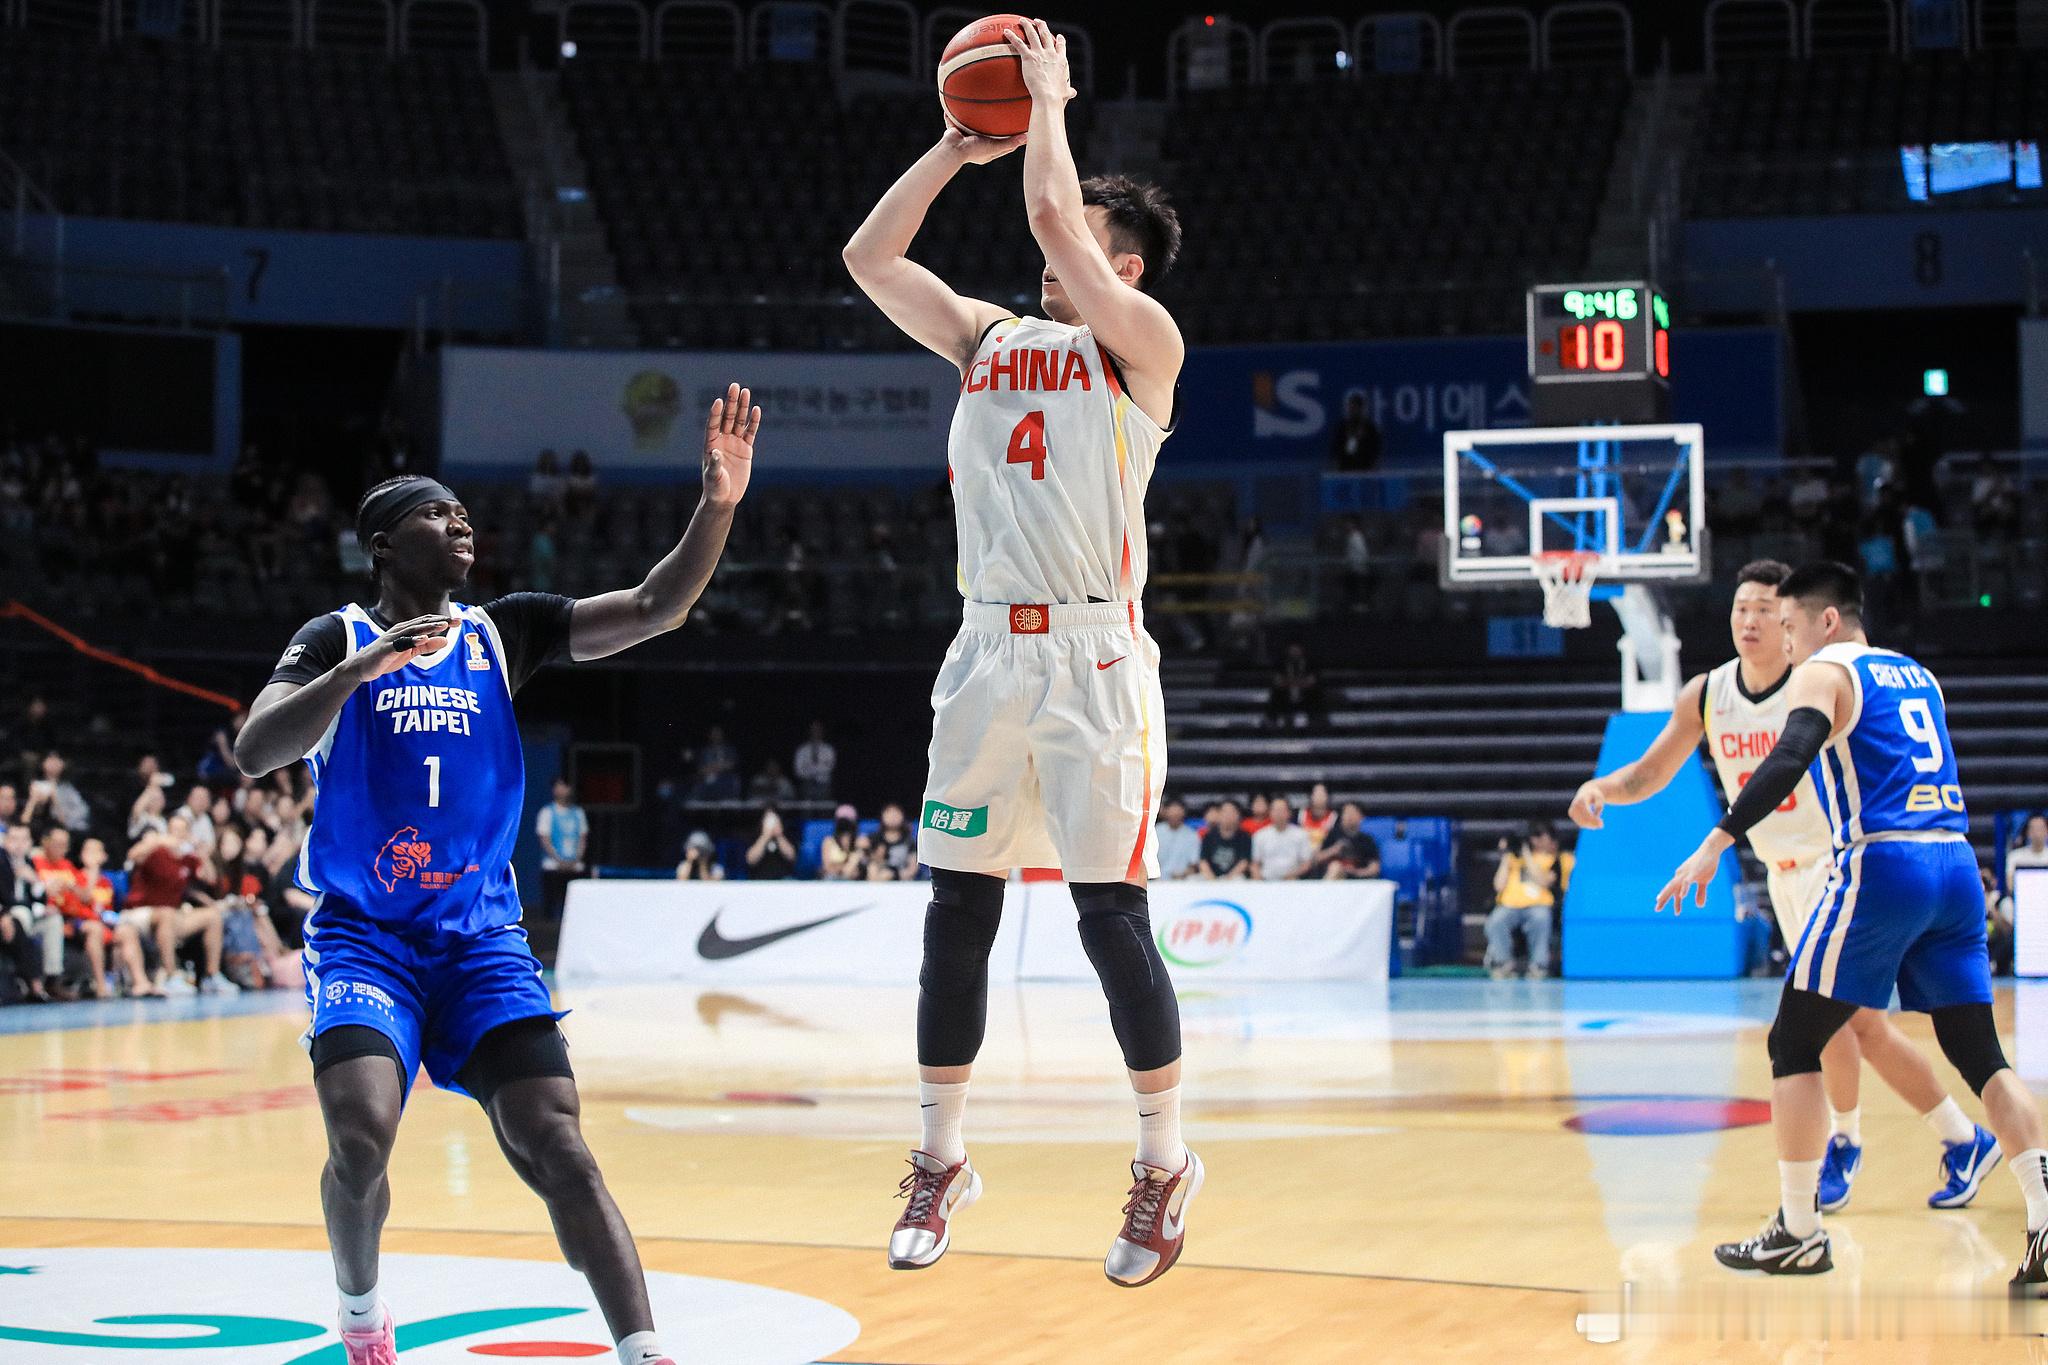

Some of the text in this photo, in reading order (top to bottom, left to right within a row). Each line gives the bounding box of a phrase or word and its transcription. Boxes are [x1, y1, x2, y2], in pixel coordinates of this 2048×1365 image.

[244, 248, 270, 303] 7
[1915, 231, 1942, 285] 8
[1563, 288, 1638, 320] 9:46
[1575, 320, 1624, 371] 10
[960, 348, 1092, 393] CHINA
[1007, 410, 1047, 480] 4
[376, 685, 481, 714] CHINESE
[392, 709, 471, 737] TAIPEI
[1720, 731, 1778, 760] CHIN
[1899, 698, 1944, 773] 9
[423, 756, 440, 807] 1
[930, 809, 973, 831] 怡寶
